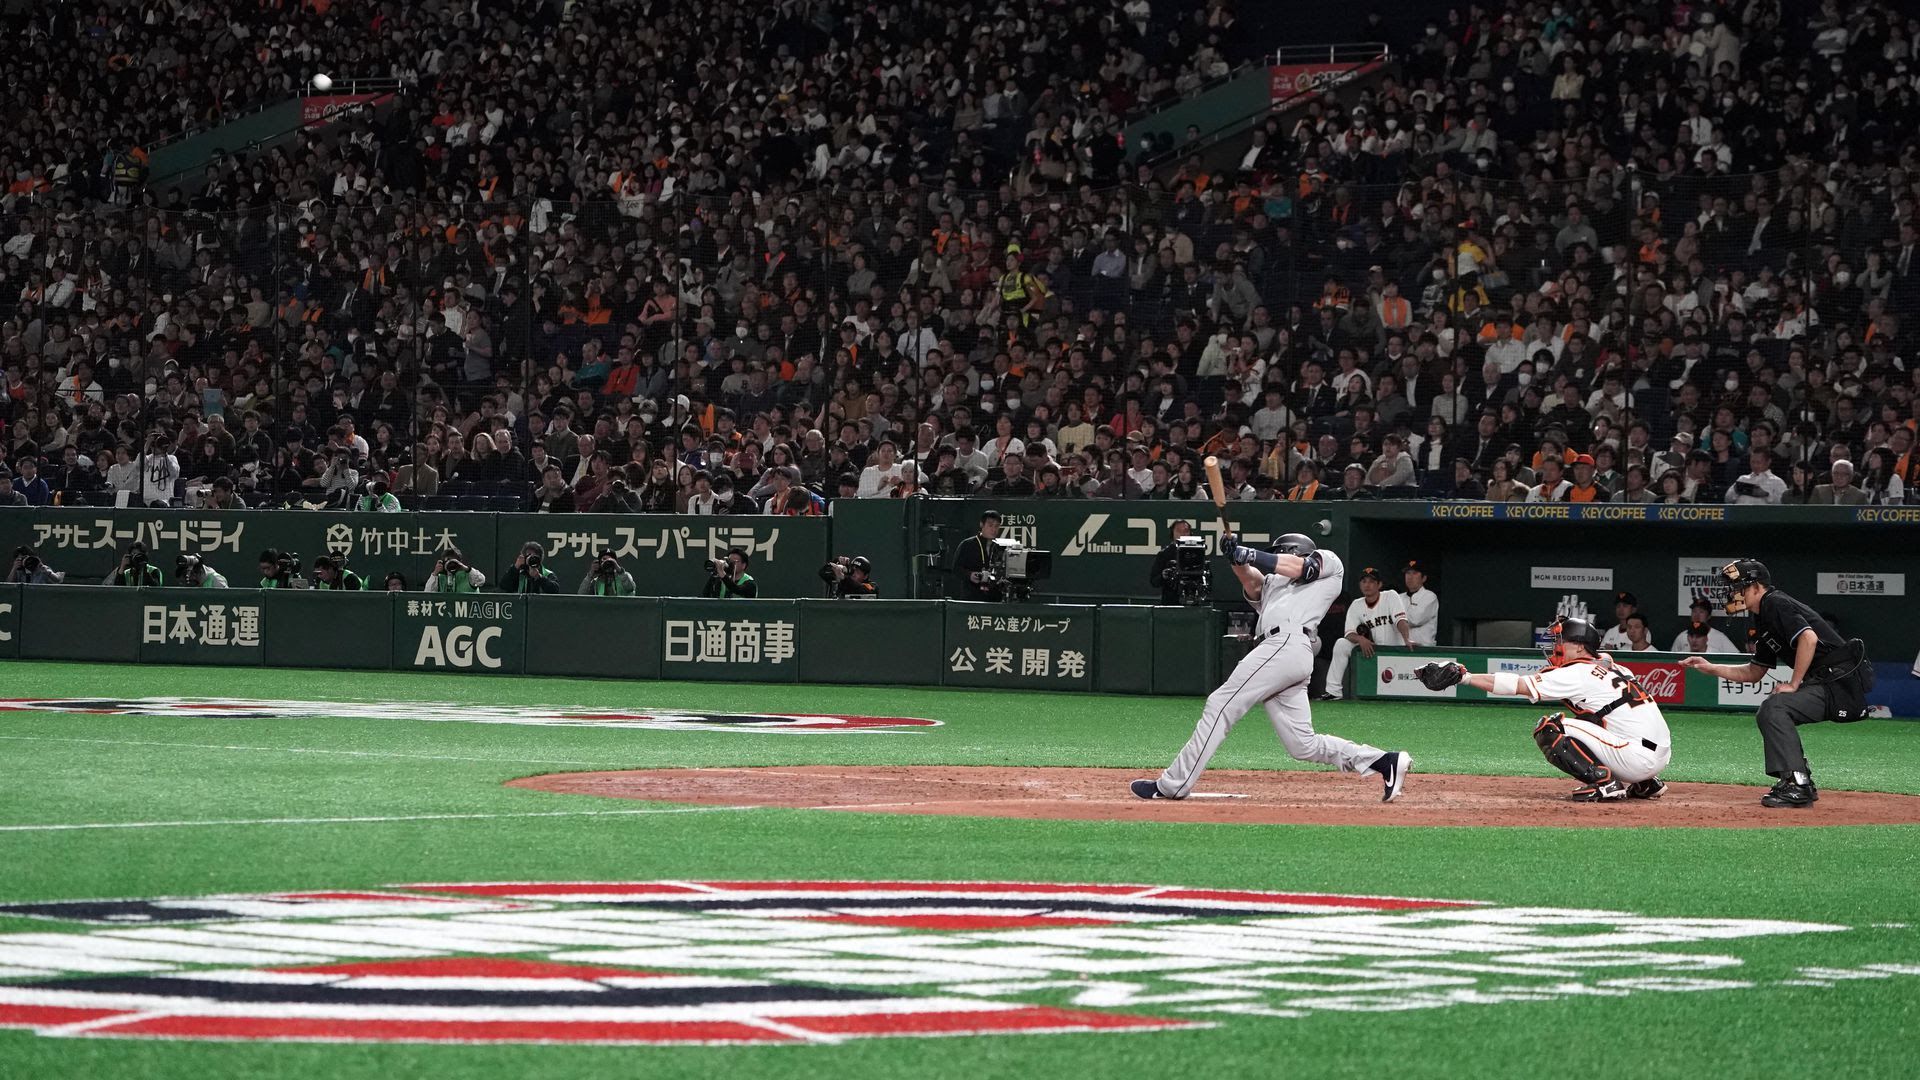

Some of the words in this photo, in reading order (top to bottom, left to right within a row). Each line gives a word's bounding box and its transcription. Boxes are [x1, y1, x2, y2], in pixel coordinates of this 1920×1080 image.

[33, 519, 244, 552] アサヒスーパードライ
[360, 527, 457, 556] 竹中土木
[143, 604, 260, 647] 日本通運
[967, 614, 1071, 634] 松戸公産グループ
[1364, 614, 1394, 629] ANTS
[414, 625, 503, 668] AGC
[665, 619, 795, 664] 日通商事
[949, 647, 1087, 678] 公栄開発
